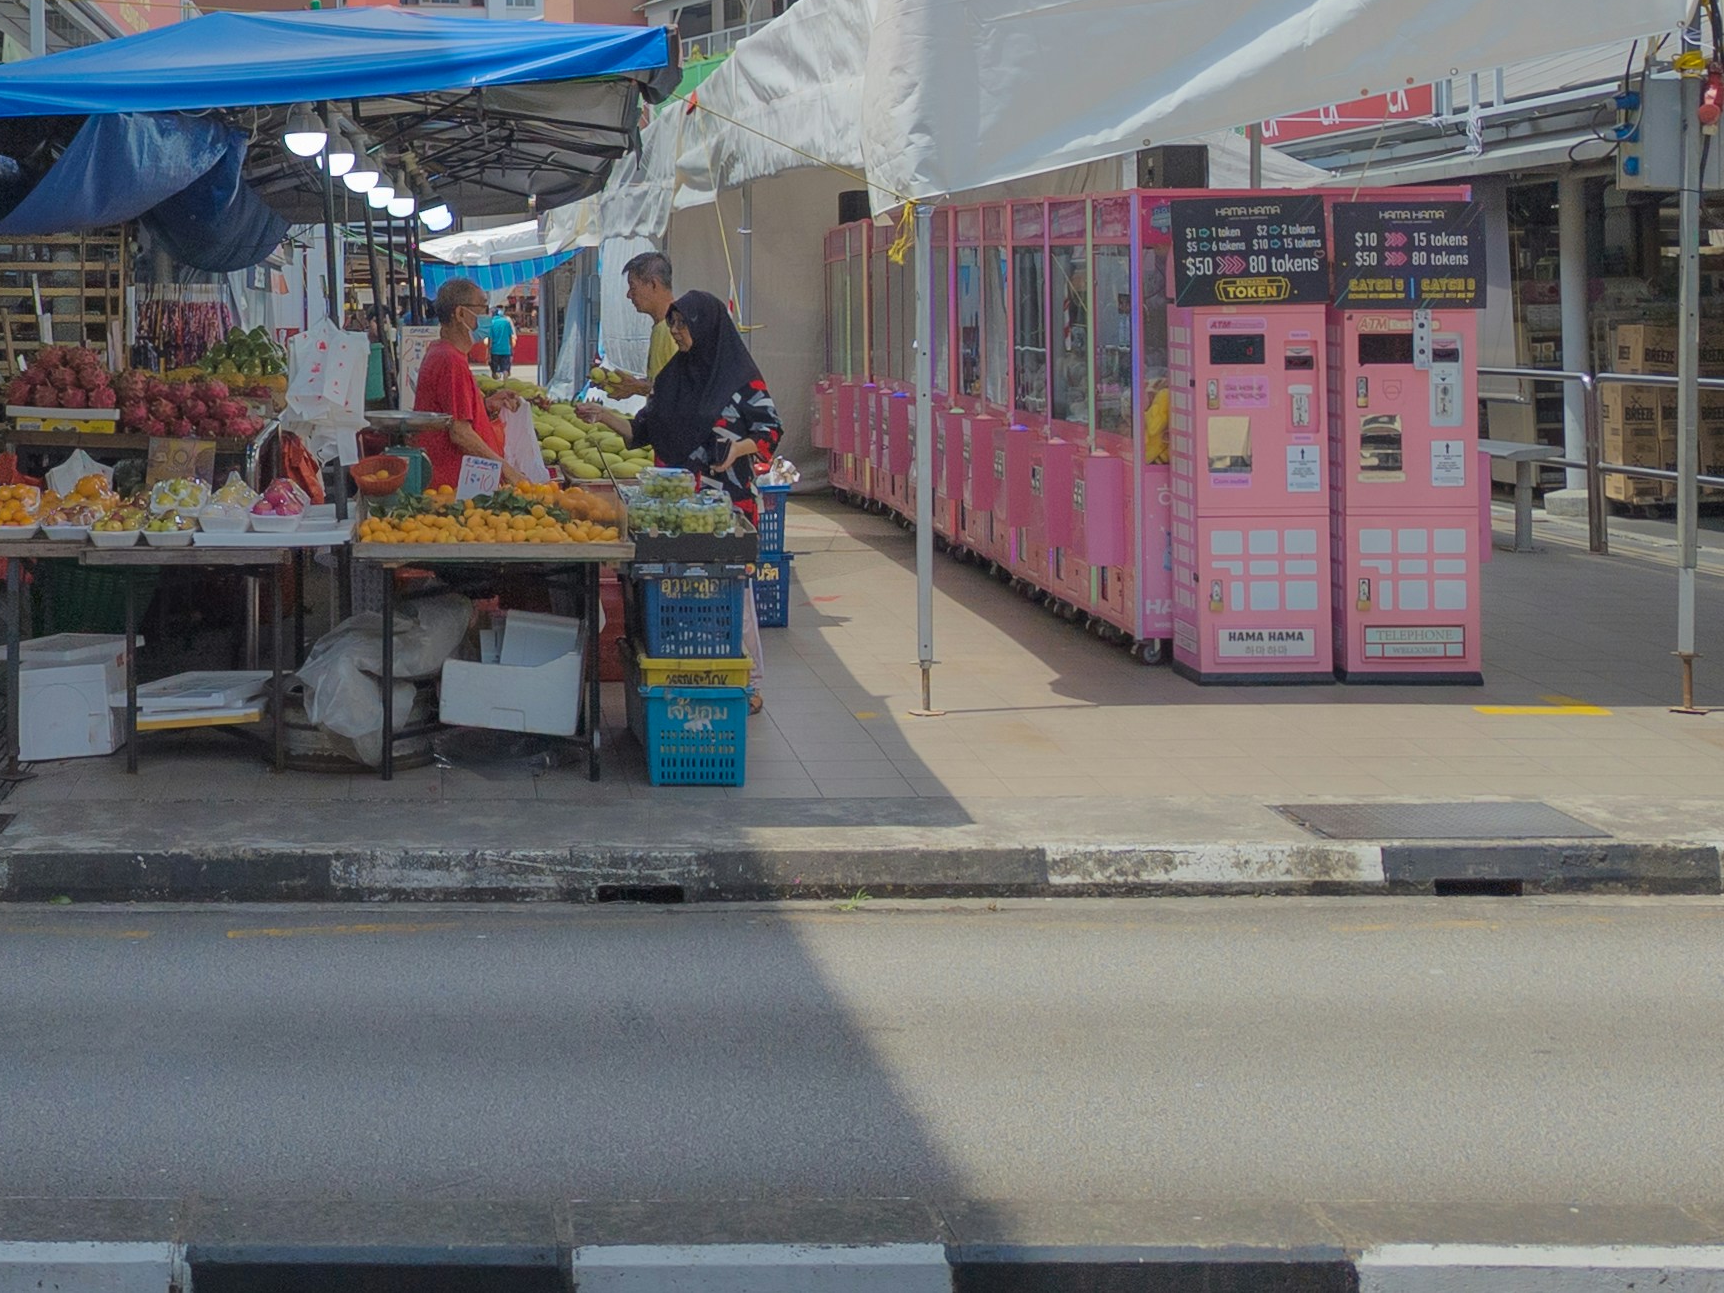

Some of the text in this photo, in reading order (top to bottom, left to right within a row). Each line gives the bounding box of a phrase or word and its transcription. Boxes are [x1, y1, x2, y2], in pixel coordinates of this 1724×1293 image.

[1215, 205, 1281, 217] HAMA HAMA
[1379, 209, 1445, 219] HAMA HAMA
[1218, 226, 1241, 237] token
[1289, 223, 1316, 235] tokens
[1218, 240, 1246, 251] tokens
[1252, 237, 1321, 250] $10 15 tokens
[1355, 231, 1469, 247] $10 15 tokens
[1186, 253, 1320, 277] $50 80 tokens
[1355, 250, 1469, 267] $50 80 tokens
[1348, 278, 1393, 292] CATCH
[1421, 277, 1465, 291] CATCH
[1226, 285, 1278, 299] TOKEN
[1210, 320, 1231, 329] ATM
[1359, 317, 1387, 330] ATM
[1644, 346, 1675, 364] BREEZE
[1625, 407, 1655, 421] BREEZE
[1229, 631, 1304, 642] HAMA HAMA
[1376, 629, 1453, 641] TELEPHONE
[1392, 646, 1438, 654] WELCOME
